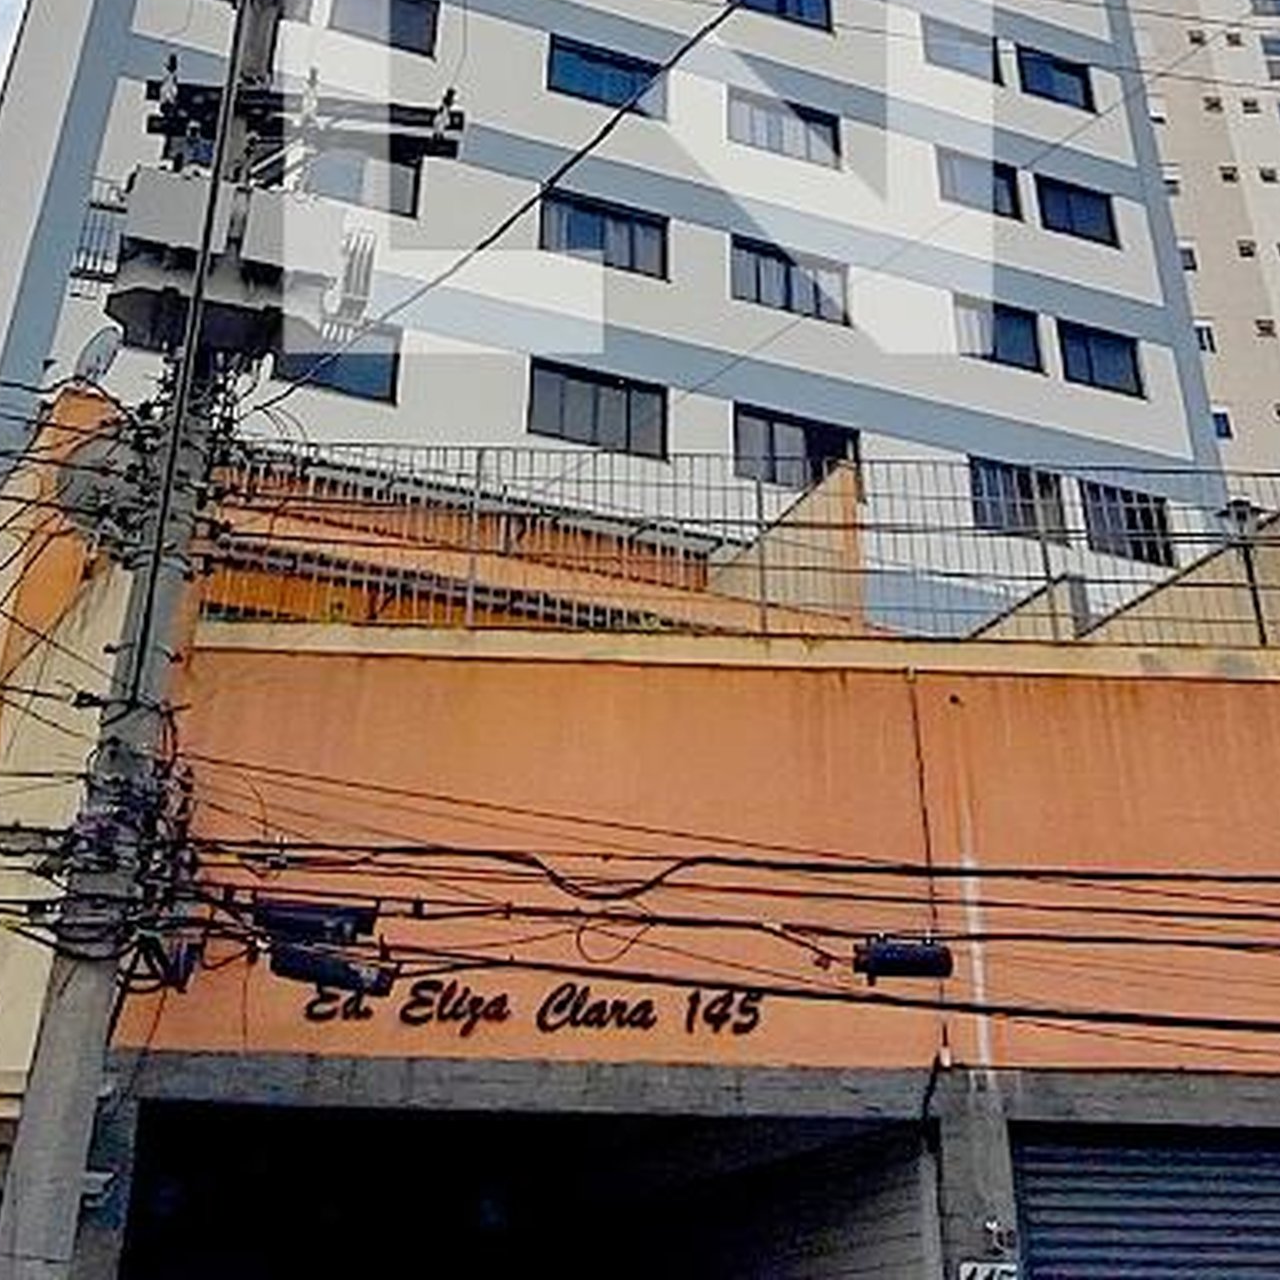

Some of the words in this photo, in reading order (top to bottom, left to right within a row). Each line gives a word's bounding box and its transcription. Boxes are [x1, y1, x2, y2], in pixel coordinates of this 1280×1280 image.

[400, 979, 511, 1037] Eliza
[536, 982, 658, 1033] Clara
[686, 988, 763, 1035] 145
